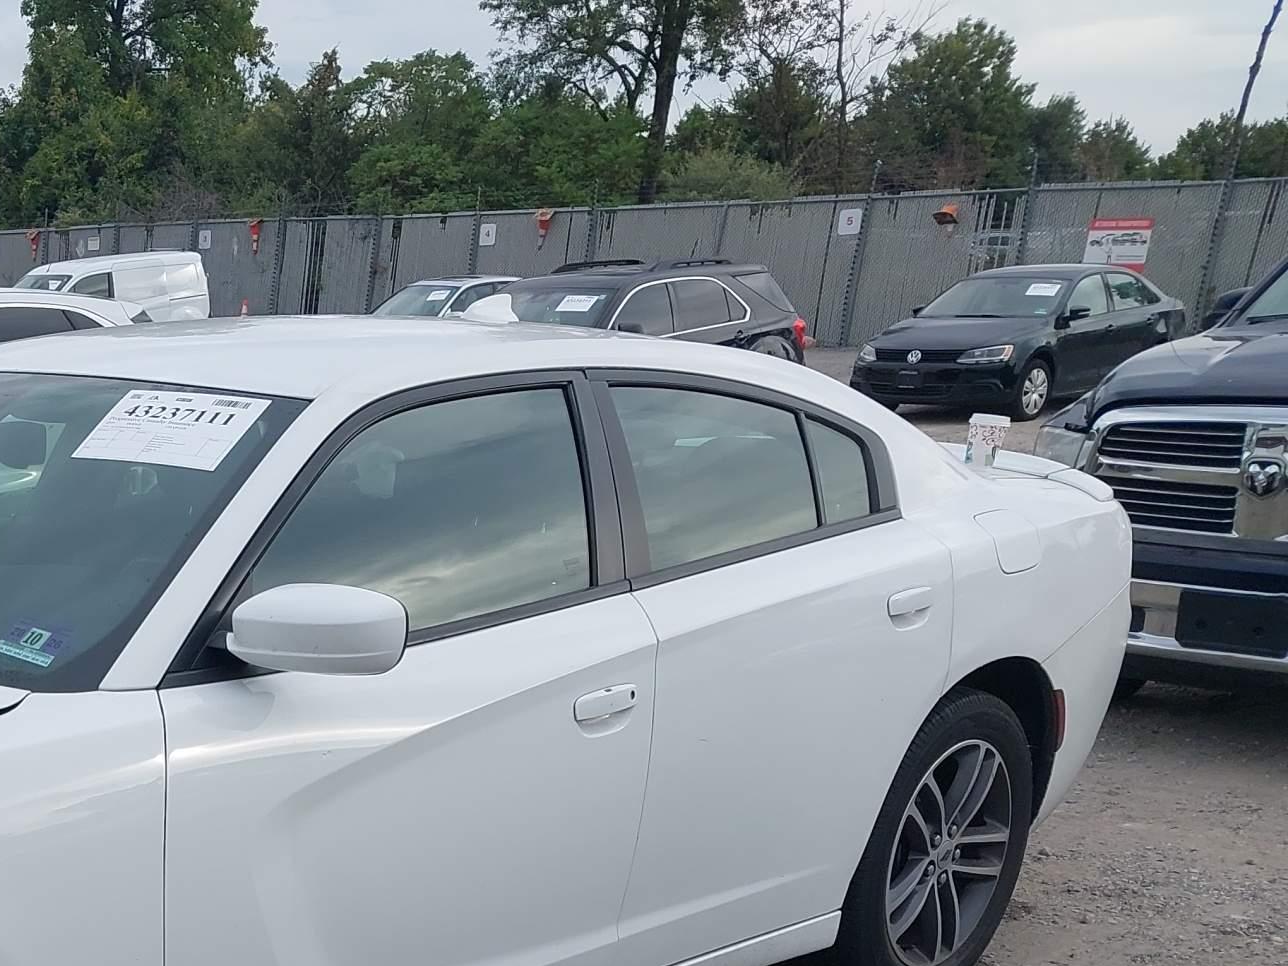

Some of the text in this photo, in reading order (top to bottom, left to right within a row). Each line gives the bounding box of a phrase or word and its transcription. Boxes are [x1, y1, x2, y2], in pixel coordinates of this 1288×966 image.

[847, 216, 854, 226] 5
[124, 404, 236, 426] 43237111
[23, 631, 44, 646] 10
